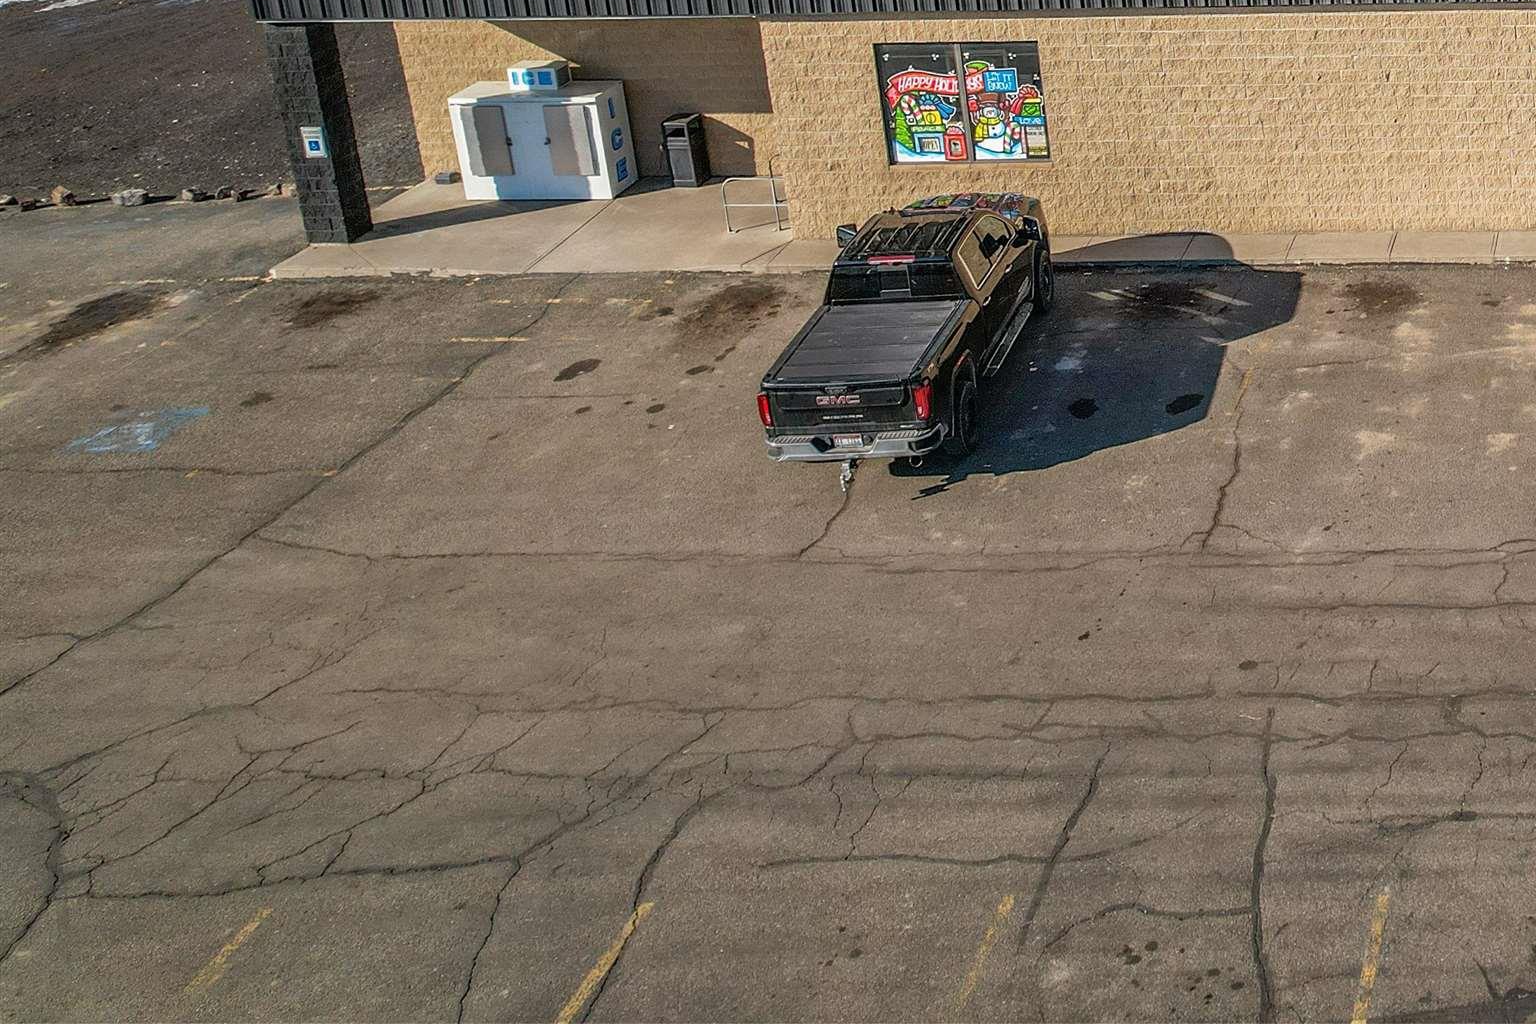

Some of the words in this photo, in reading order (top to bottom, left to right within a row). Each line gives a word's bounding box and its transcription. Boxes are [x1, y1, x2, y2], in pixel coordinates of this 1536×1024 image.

[511, 71, 553, 85] ICE
[898, 76, 932, 92] HAPPY
[1003, 73, 1013, 82] IT
[608, 97, 629, 182] ICE
[816, 395, 860, 406] GMC
